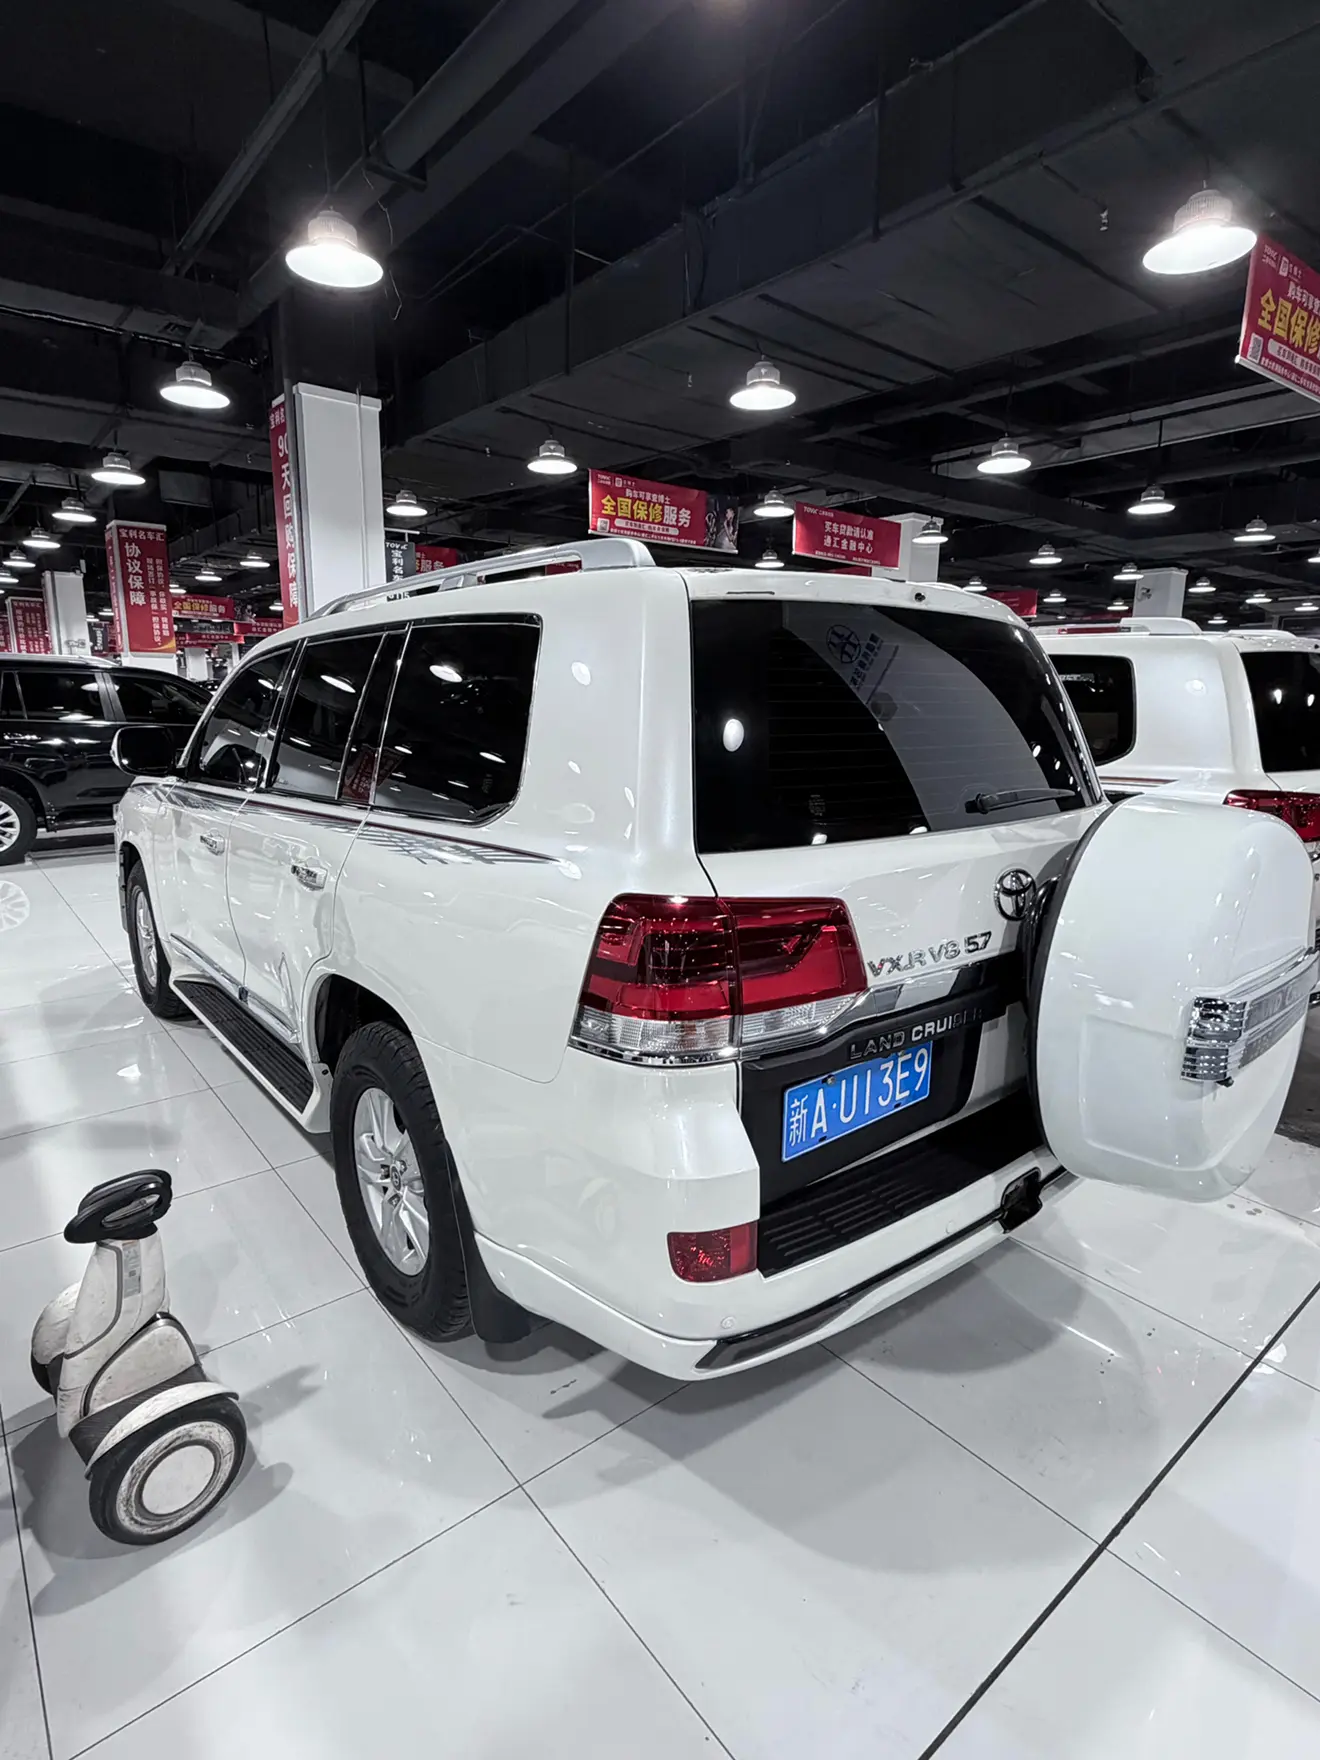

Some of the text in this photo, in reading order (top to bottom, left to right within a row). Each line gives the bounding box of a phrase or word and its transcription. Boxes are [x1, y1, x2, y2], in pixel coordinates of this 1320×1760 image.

[1257, 288, 1320, 358] 全国保修
[601, 494, 692, 528] 全国保修服务
[824, 521, 874, 540] 买车贷款请认准
[823, 535, 873, 554] 通汇金融中心
[124, 542, 146, 606] 协议保障
[850, 1008, 983, 1060] LAND CRUIS
